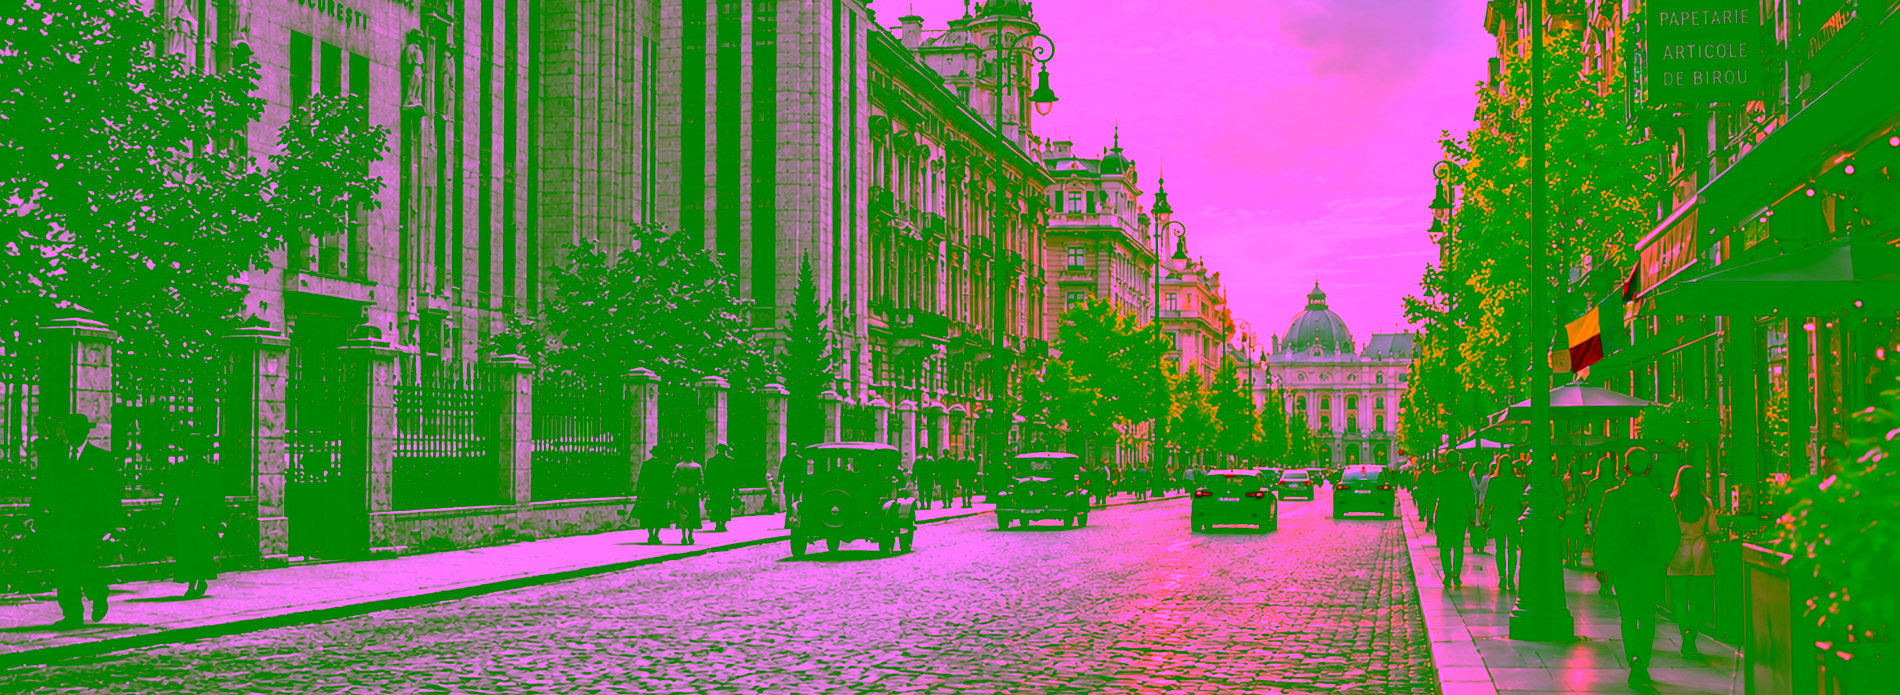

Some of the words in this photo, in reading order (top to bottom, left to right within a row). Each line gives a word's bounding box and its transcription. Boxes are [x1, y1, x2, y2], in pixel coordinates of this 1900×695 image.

[1662, 42, 1747, 60] ARTICOLE
[1663, 71, 1684, 86] DE
[1693, 69, 1747, 85] BIROU
